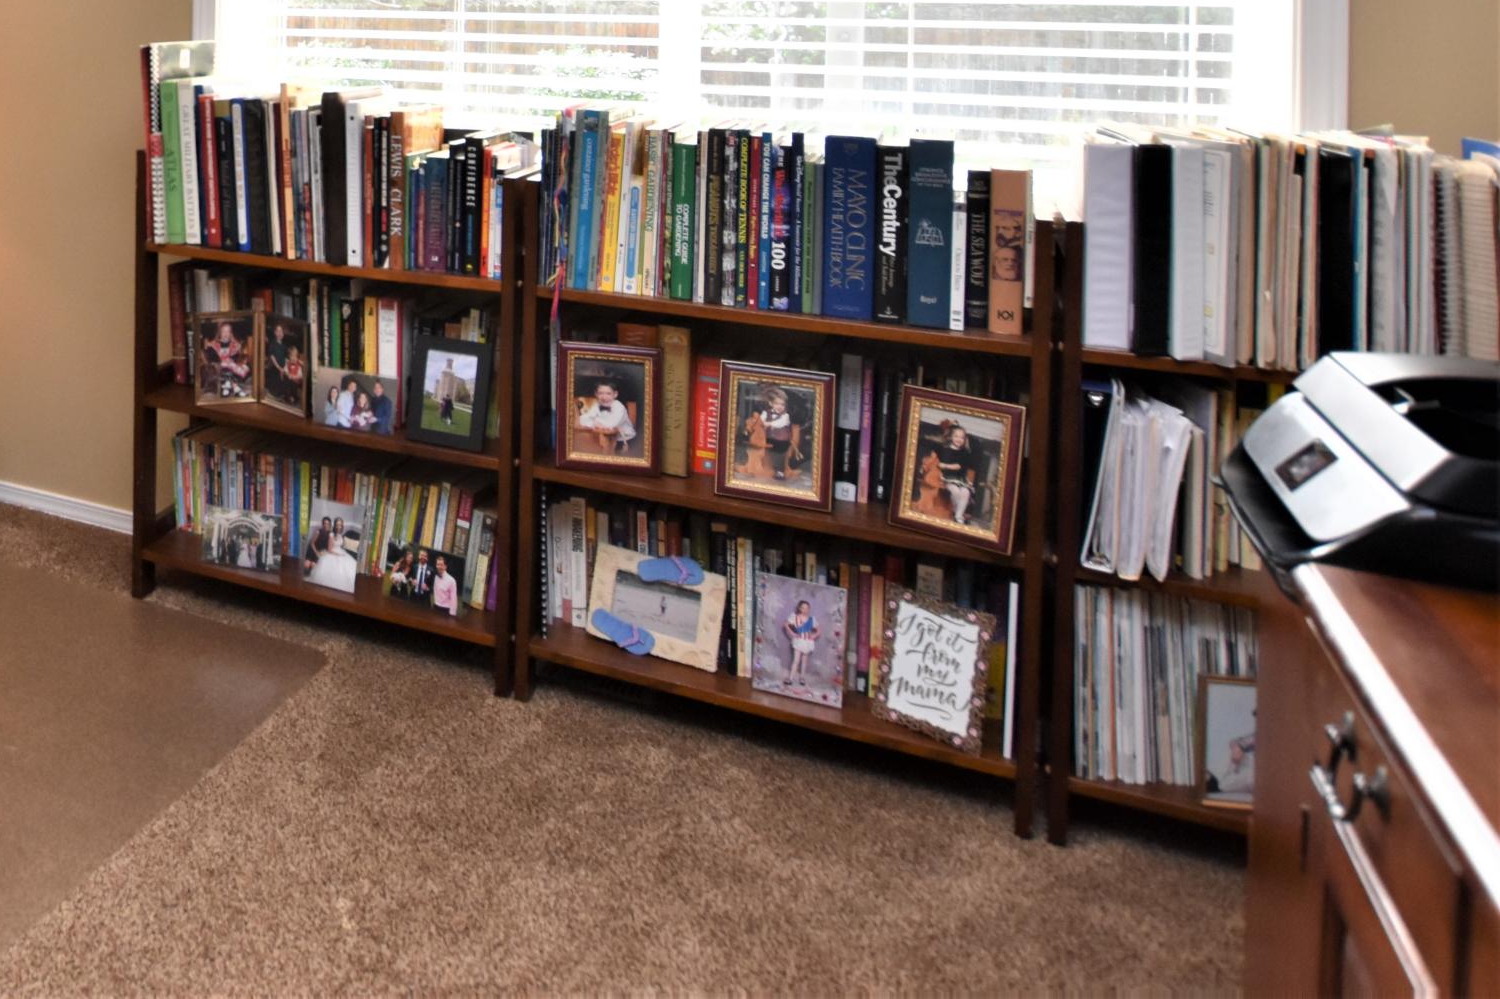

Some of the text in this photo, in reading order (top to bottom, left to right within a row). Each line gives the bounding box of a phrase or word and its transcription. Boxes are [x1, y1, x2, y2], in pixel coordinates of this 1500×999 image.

[166, 150, 177, 192] ATLAS
[182, 104, 196, 231] GREAT MILITARY BATTLES
[465, 146, 476, 207] CONFIDENCE
[740, 137, 749, 179] COMPLETE
[390, 134, 403, 237] LEWIS CLARK
[740, 179, 748, 202] BOOK
[761, 142, 771, 239] YOU CAN CHANGE THE WORLD
[674, 203, 683, 256] TO GARDENING
[681, 203, 690, 241] COMPLETE
[738, 212, 748, 244] TENNIS
[829, 167, 845, 289] FAMILY HEALTH BOOK
[845, 168, 868, 291] MAYO CLINIC
[971, 211, 986, 234] THE
[680, 242, 689, 265] GUIDE
[770, 241, 787, 270] 100
[970, 235, 986, 256] SEA
[970, 257, 986, 288] WOLF
[706, 386, 719, 449] French
[898, 612, 918, 637] I
[909, 616, 945, 648] got
[905, 640, 961, 674] from
[916, 662, 958, 688] my
[890, 675, 970, 712] mama
